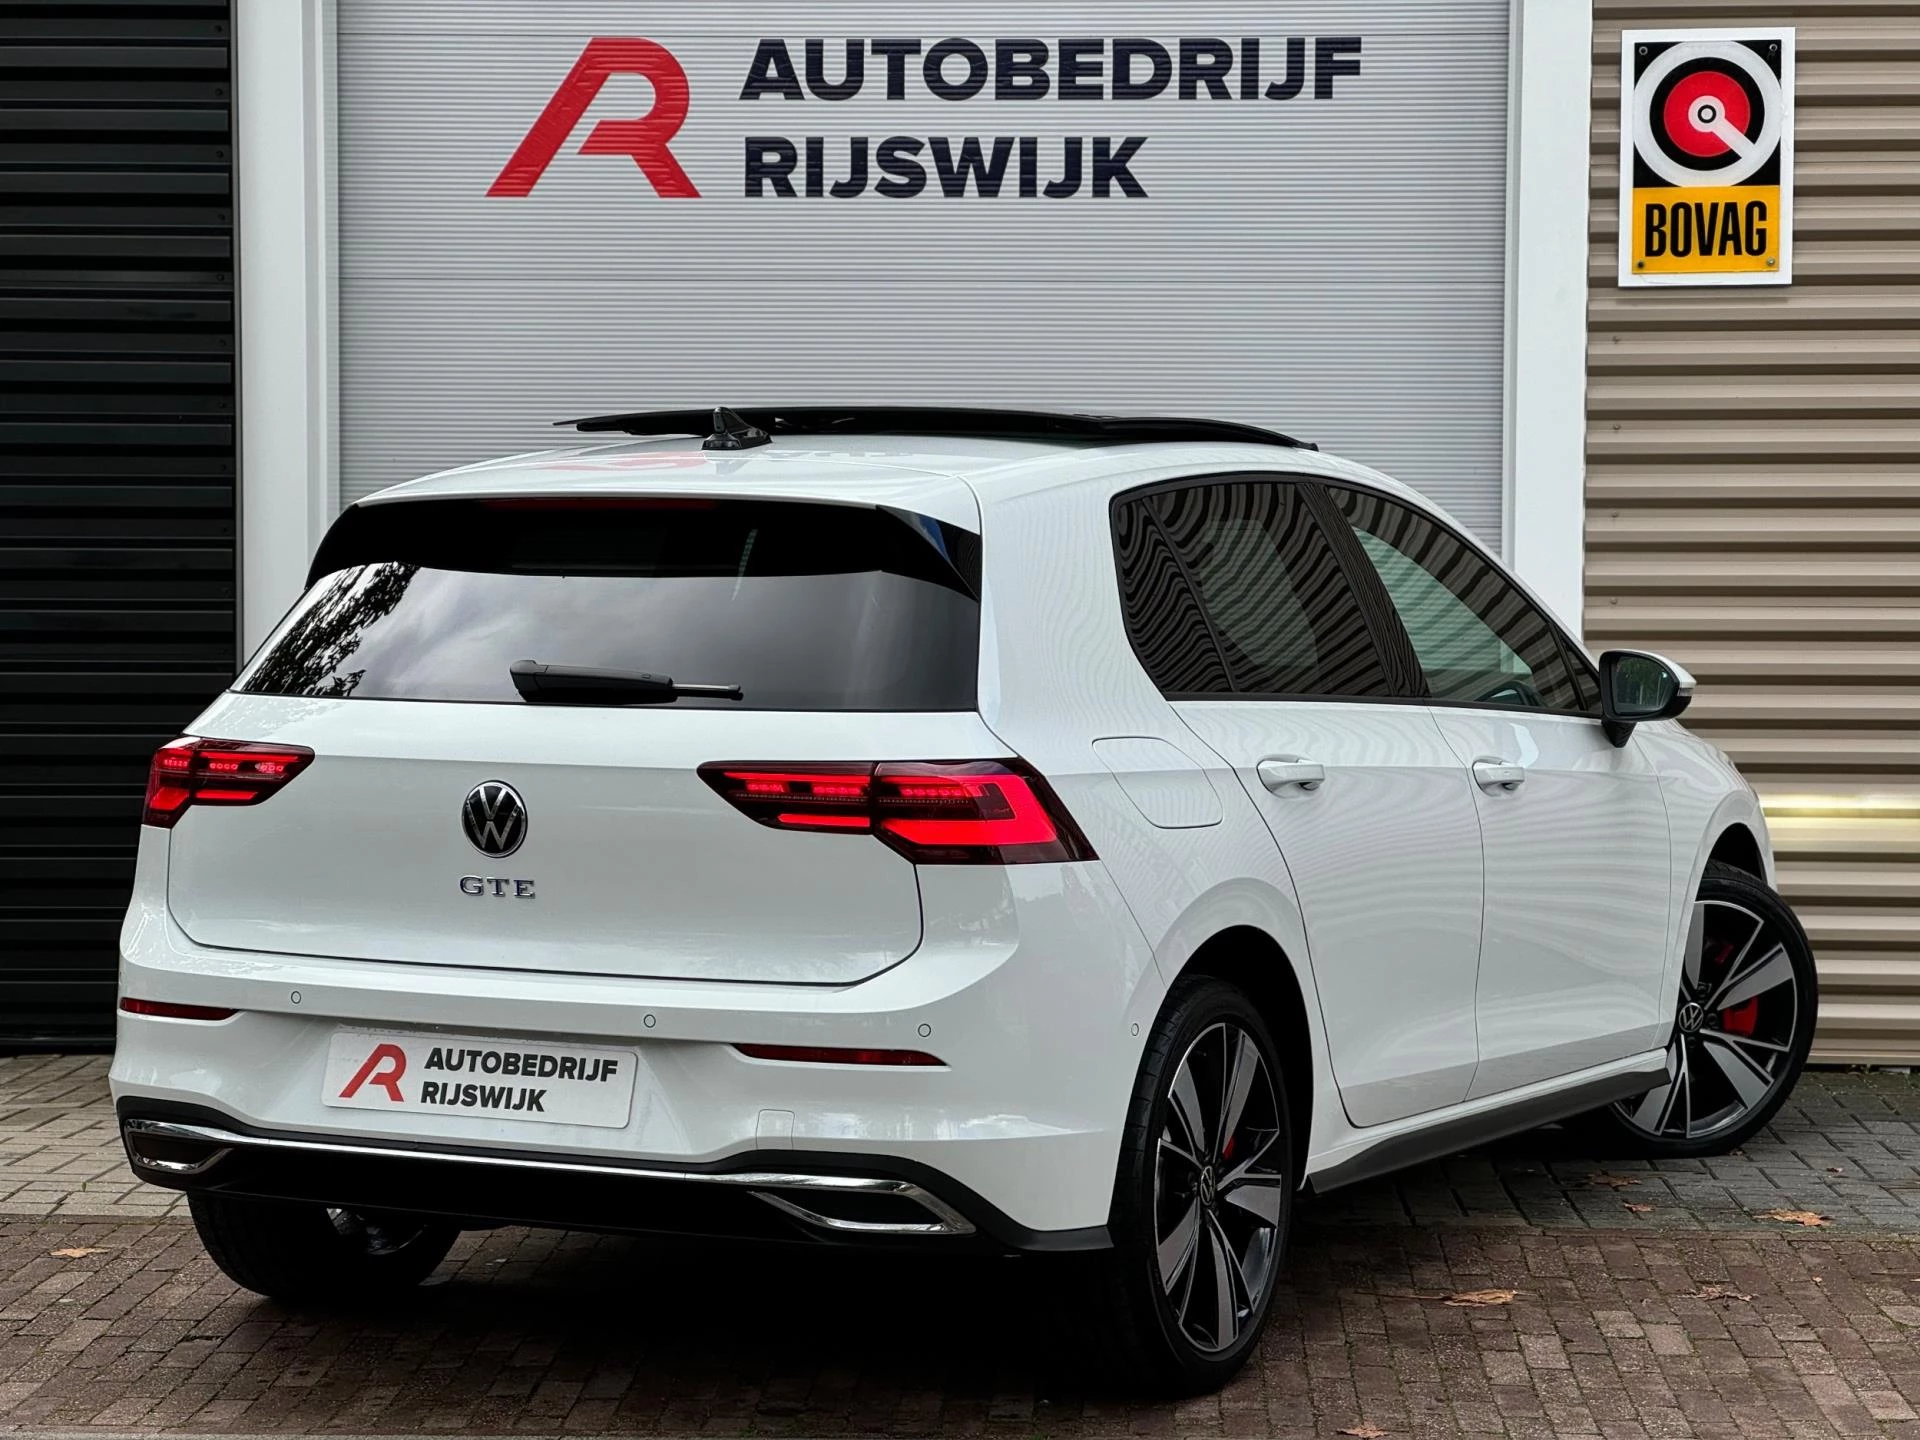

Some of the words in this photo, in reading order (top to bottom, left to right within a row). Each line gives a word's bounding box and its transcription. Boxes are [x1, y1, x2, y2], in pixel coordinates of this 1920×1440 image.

[739, 37, 1362, 101] AUTOBEDRIJF
[744, 136, 1149, 199] RIJSWIJK
[1645, 200, 1768, 257] BOVAG
[460, 875, 536, 898] GTE
[424, 1047, 619, 1082] AUTOBEDRIJF
[420, 1081, 547, 1112] RIJSWIJK
